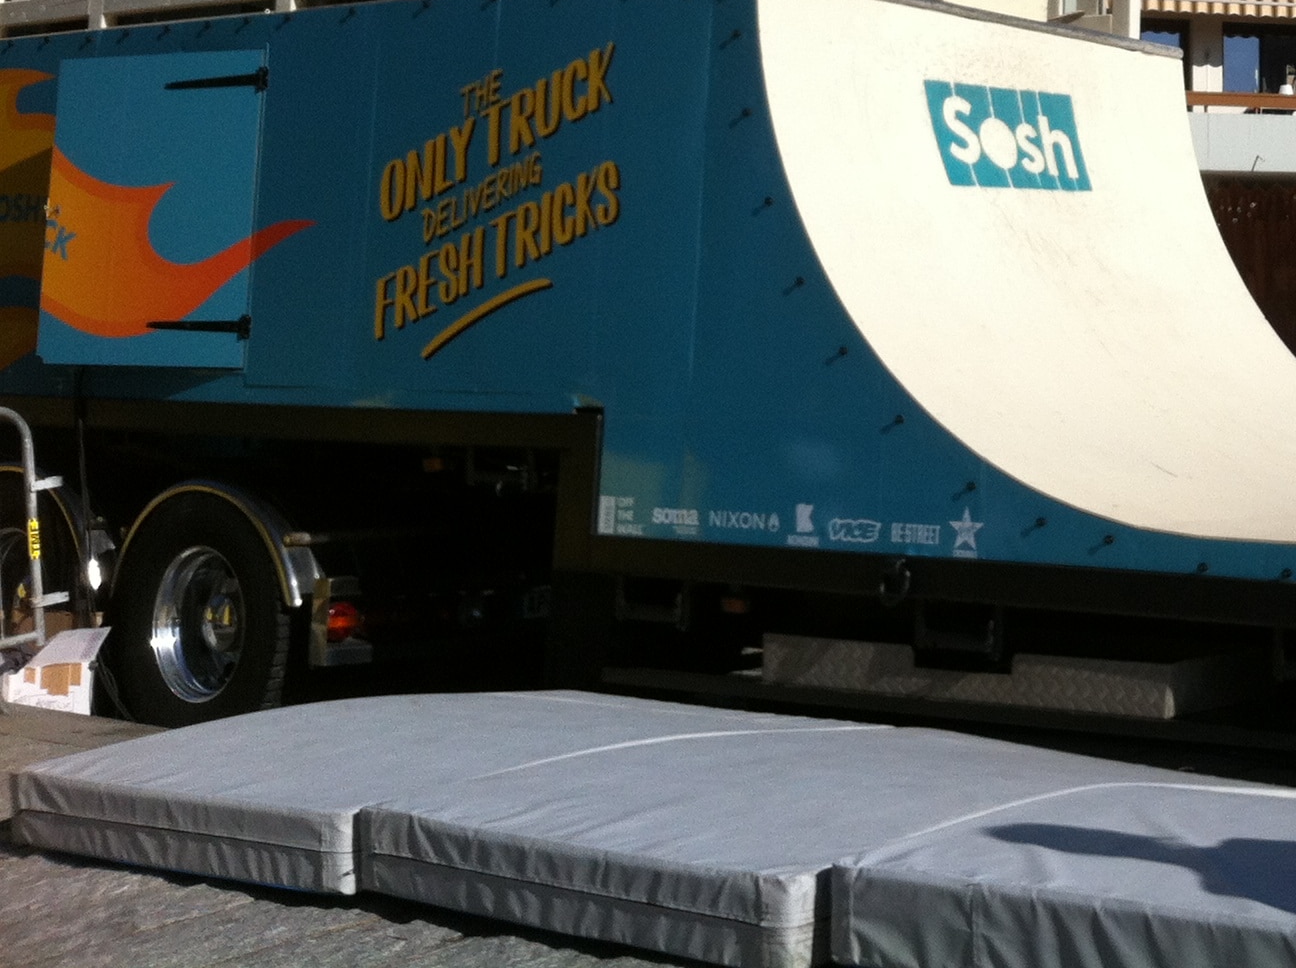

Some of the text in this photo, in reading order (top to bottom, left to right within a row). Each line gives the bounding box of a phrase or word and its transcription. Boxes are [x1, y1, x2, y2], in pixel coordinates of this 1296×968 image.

[379, 40, 616, 222] ONLY TRUCK
[460, 69, 503, 117] THE
[942, 95, 1079, 179] Sosh
[421, 150, 543, 244] DELIVERING
[374, 160, 621, 341] FRESH TRICKS
[709, 510, 766, 530] NIXON
